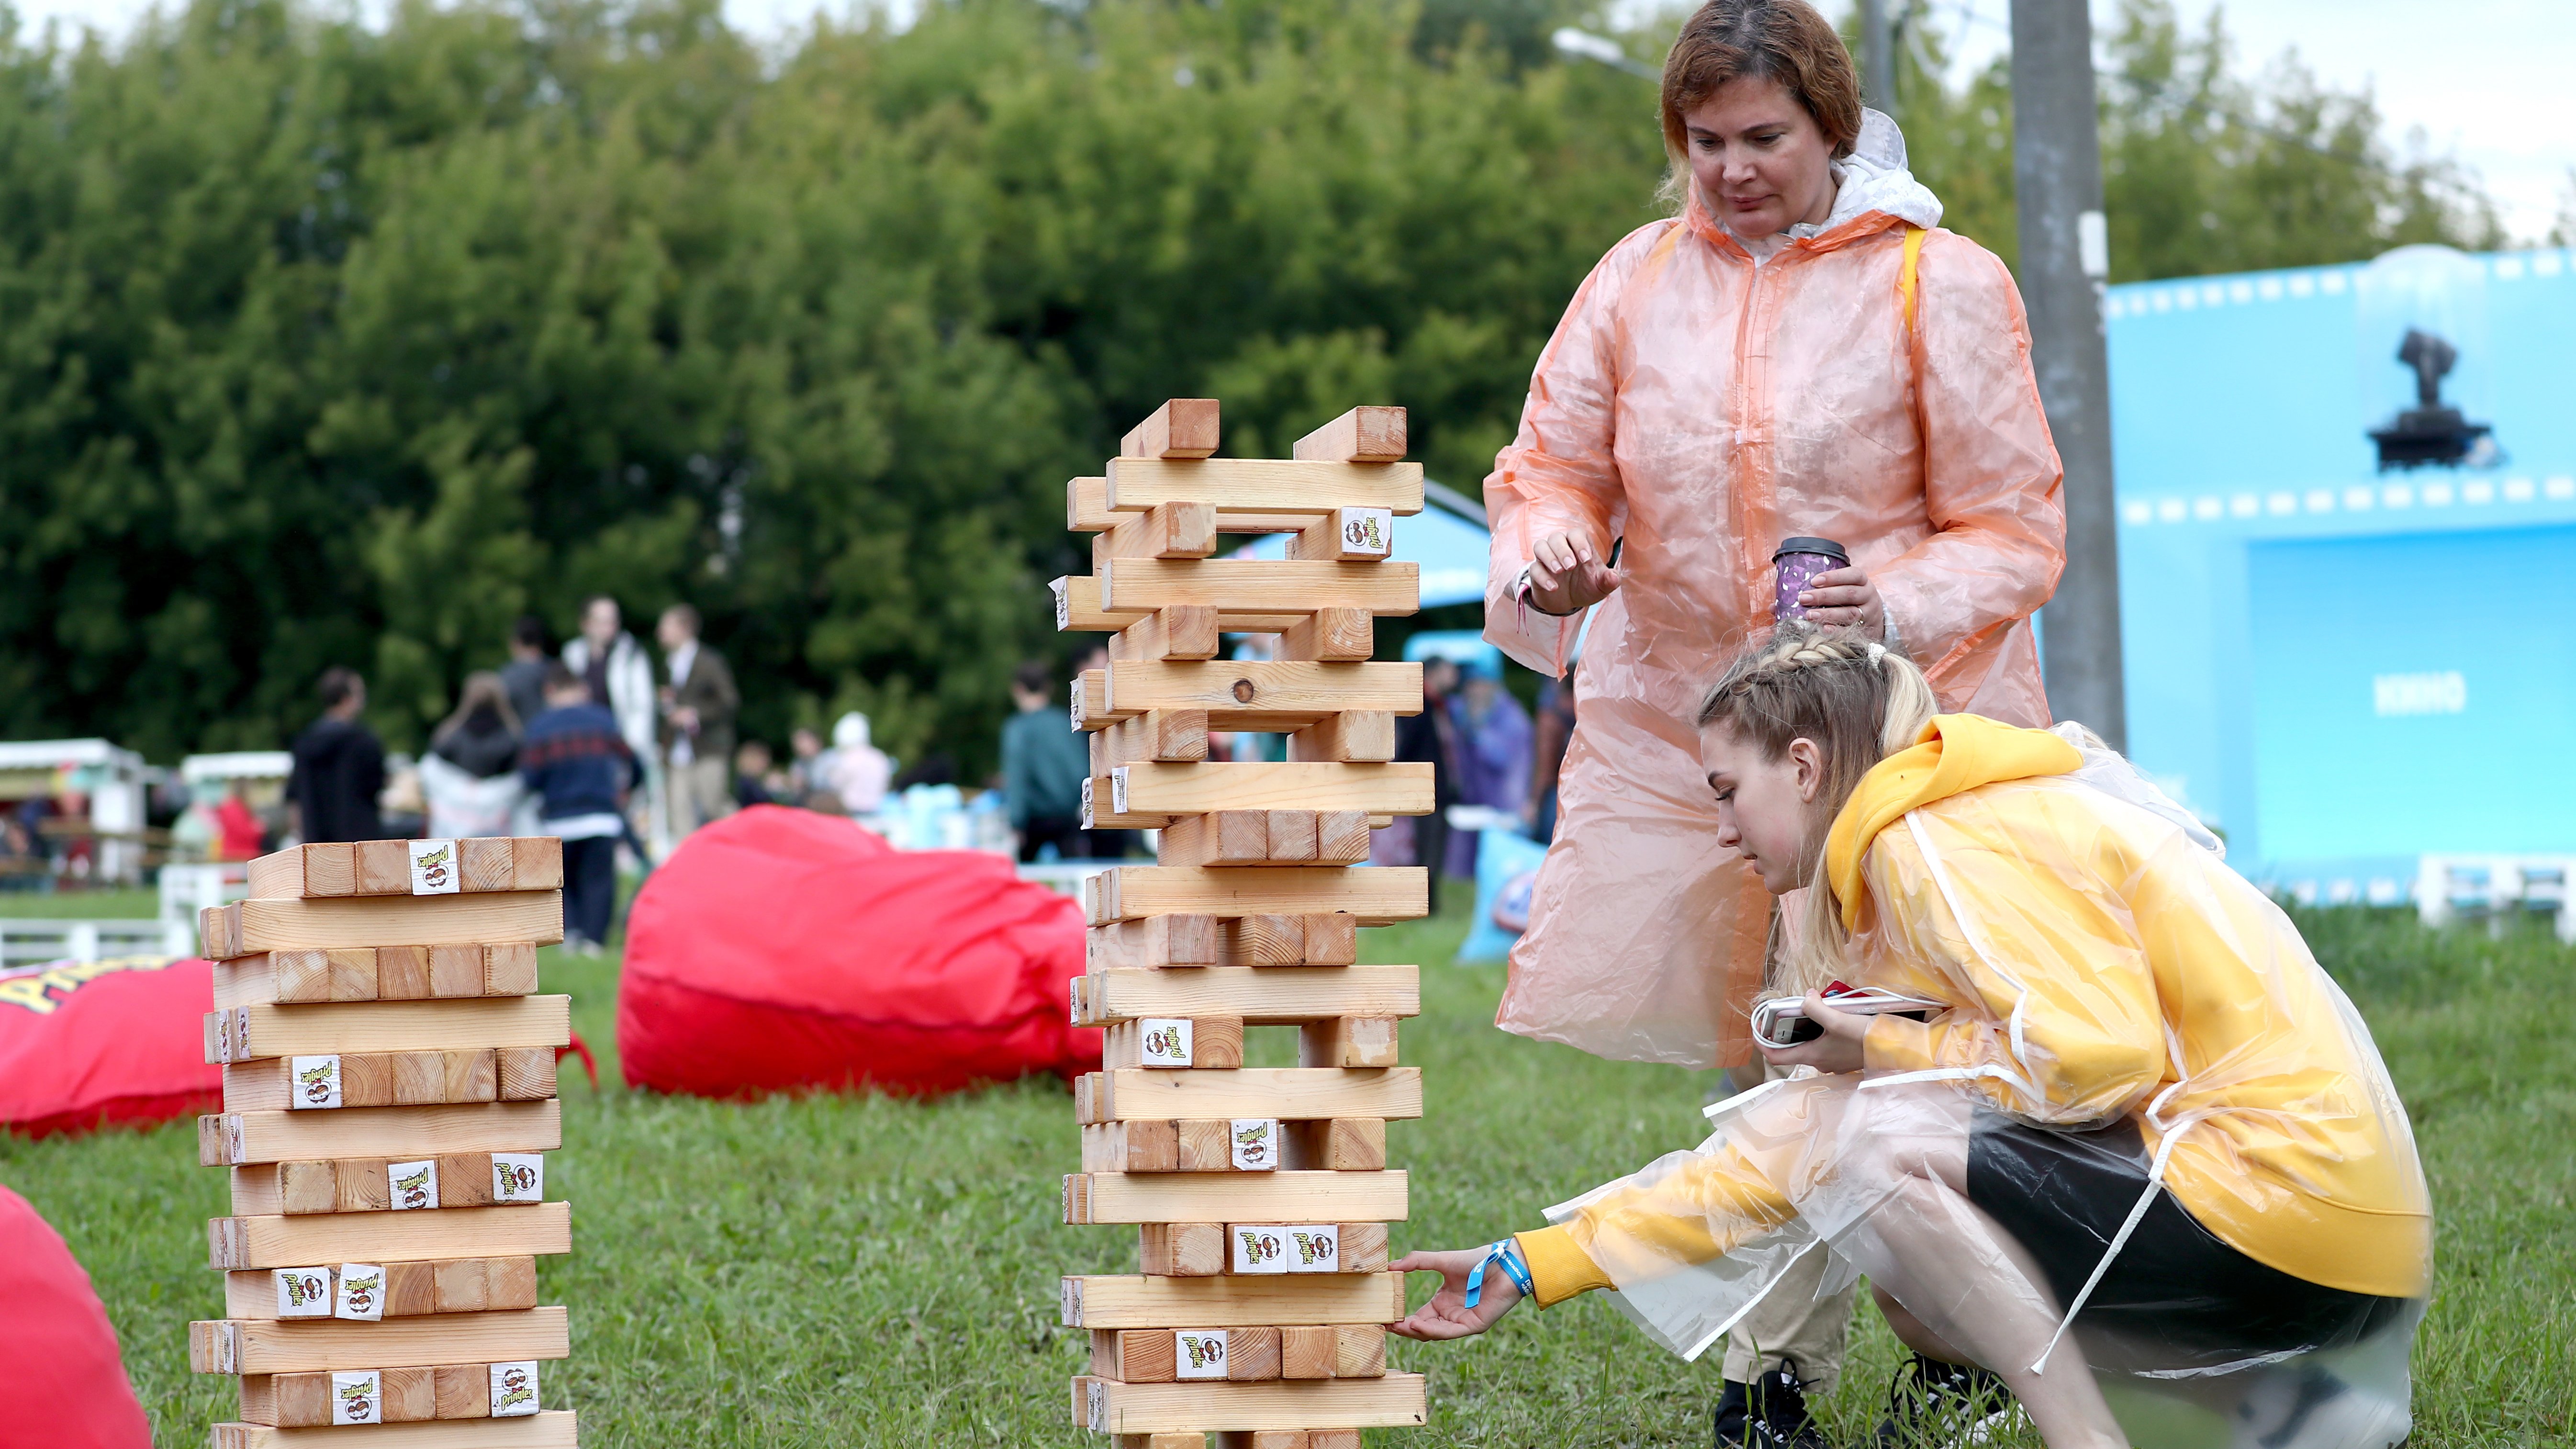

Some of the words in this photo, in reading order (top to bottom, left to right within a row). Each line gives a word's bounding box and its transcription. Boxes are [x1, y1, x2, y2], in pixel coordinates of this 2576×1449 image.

[1366, 517, 1383, 549] Pringles
[2375, 672, 2465, 716] КИНО
[418, 845, 450, 868] Pringles
[1166, 1027, 1186, 1058] Pringles
[302, 1061, 333, 1084] Pringles
[1238, 1122, 1268, 1144] Pringles
[398, 1168, 429, 1191] Pringles
[494, 1163, 515, 1195] Pringles
[1240, 1232, 1260, 1264] Pringles
[1292, 1233, 1313, 1264] Pringles
[281, 1274, 302, 1306] Pringles
[346, 1273, 378, 1292] Pringles
[1182, 1337, 1203, 1368] Pringles
[341, 1378, 373, 1400] Pringles
[502, 1388, 533, 1410] Pringles
